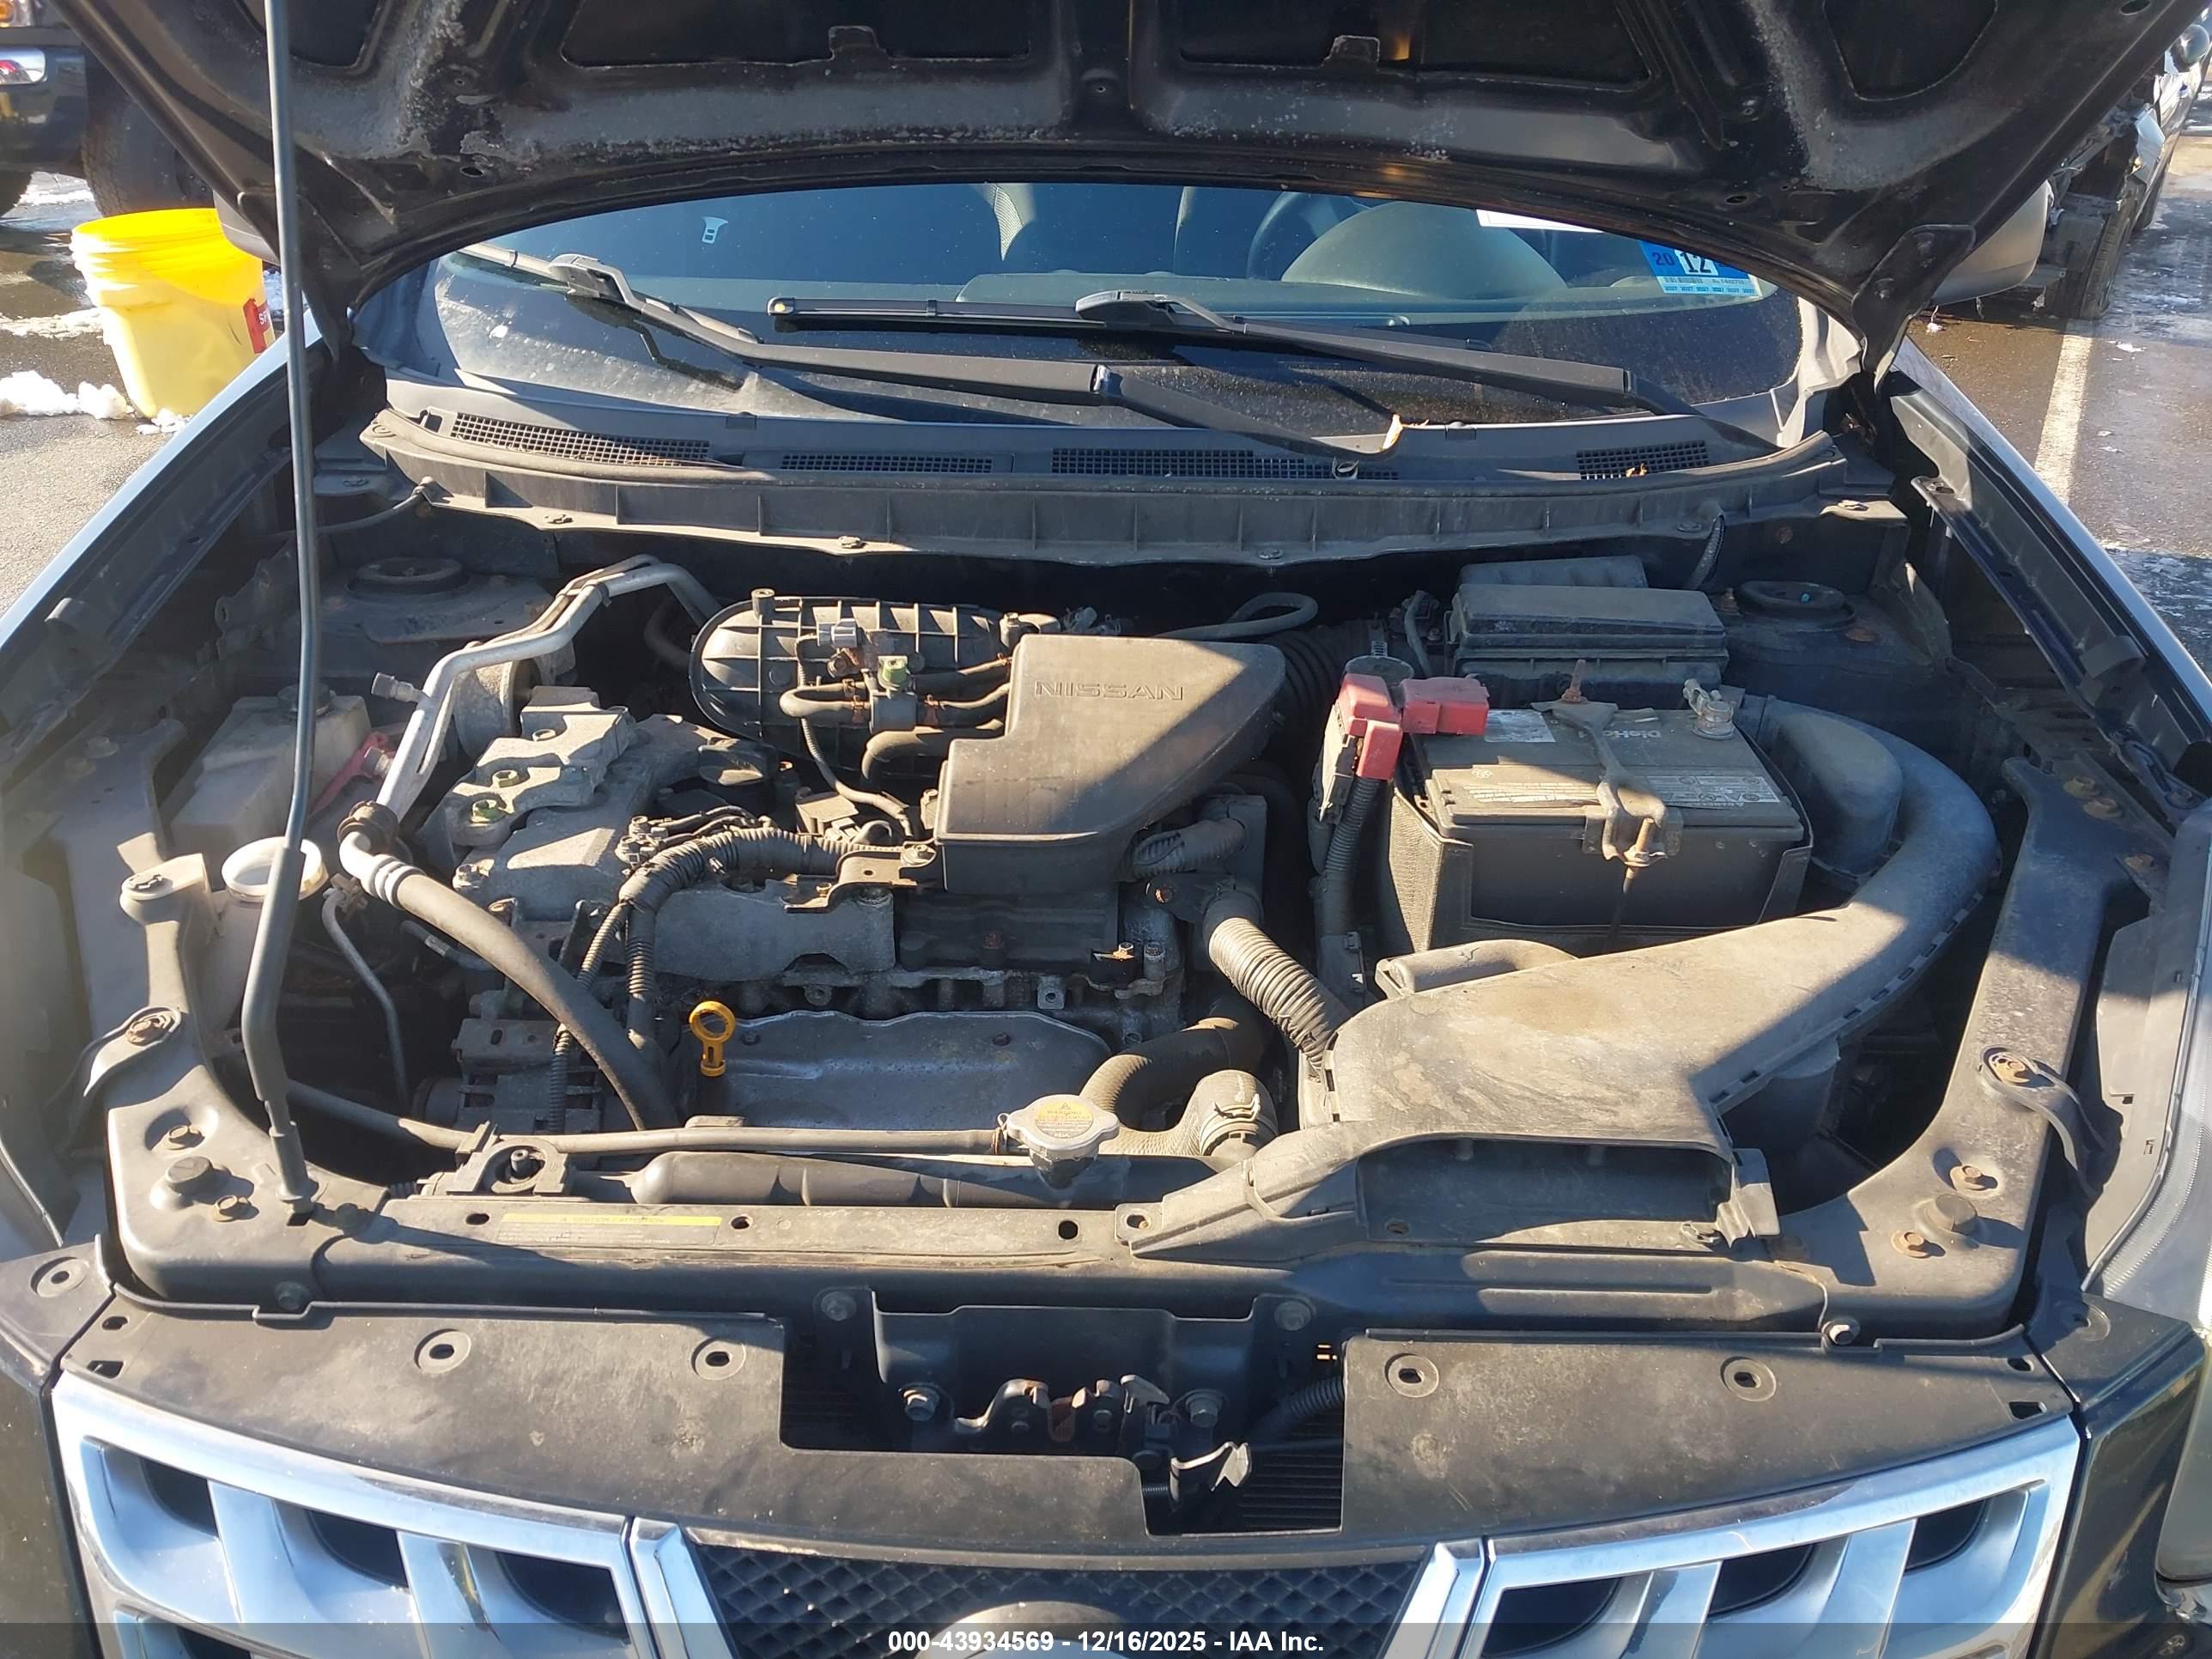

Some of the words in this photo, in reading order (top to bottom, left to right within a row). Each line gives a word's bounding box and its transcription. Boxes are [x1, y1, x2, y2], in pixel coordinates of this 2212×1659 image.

[1652, 252, 1675, 266] 20
[1680, 251, 1711, 273] 12
[1034, 679, 1184, 702] NISSAN
